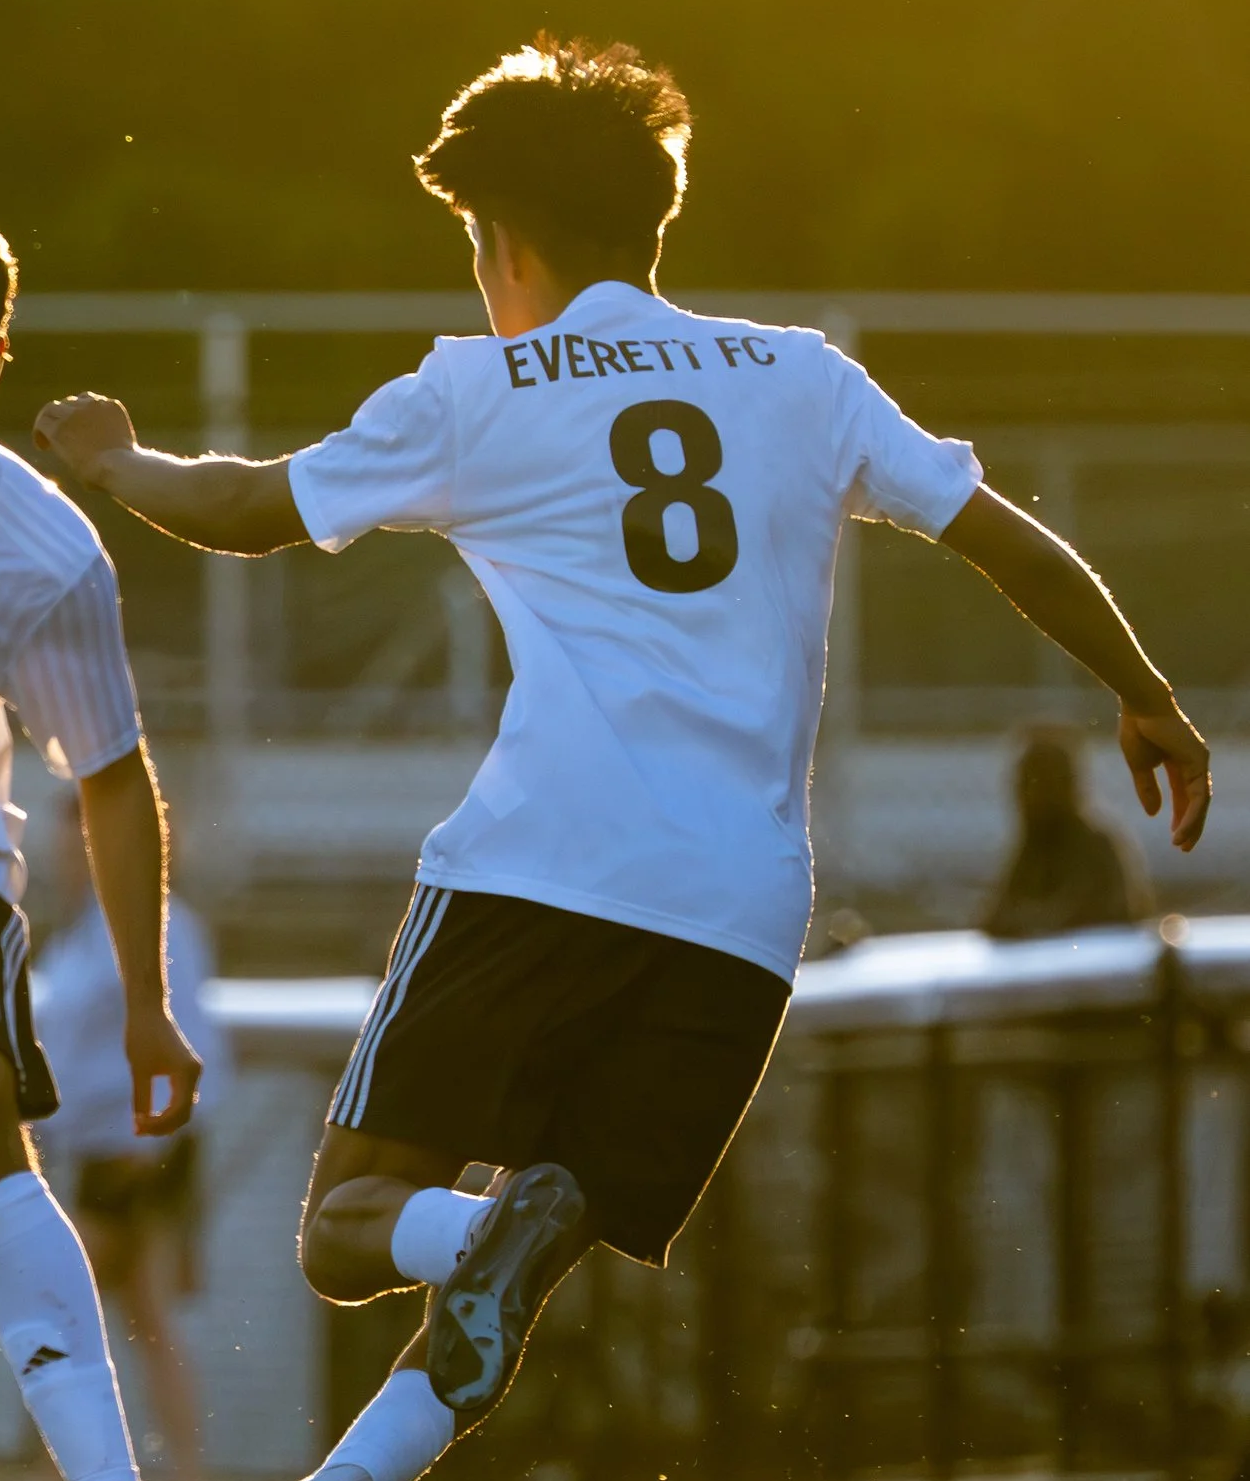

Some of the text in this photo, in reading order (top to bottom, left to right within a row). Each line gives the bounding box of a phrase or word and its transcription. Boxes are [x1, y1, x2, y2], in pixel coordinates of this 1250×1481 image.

[504, 334, 776, 388] EVERETT FC
[609, 399, 739, 593] 8
